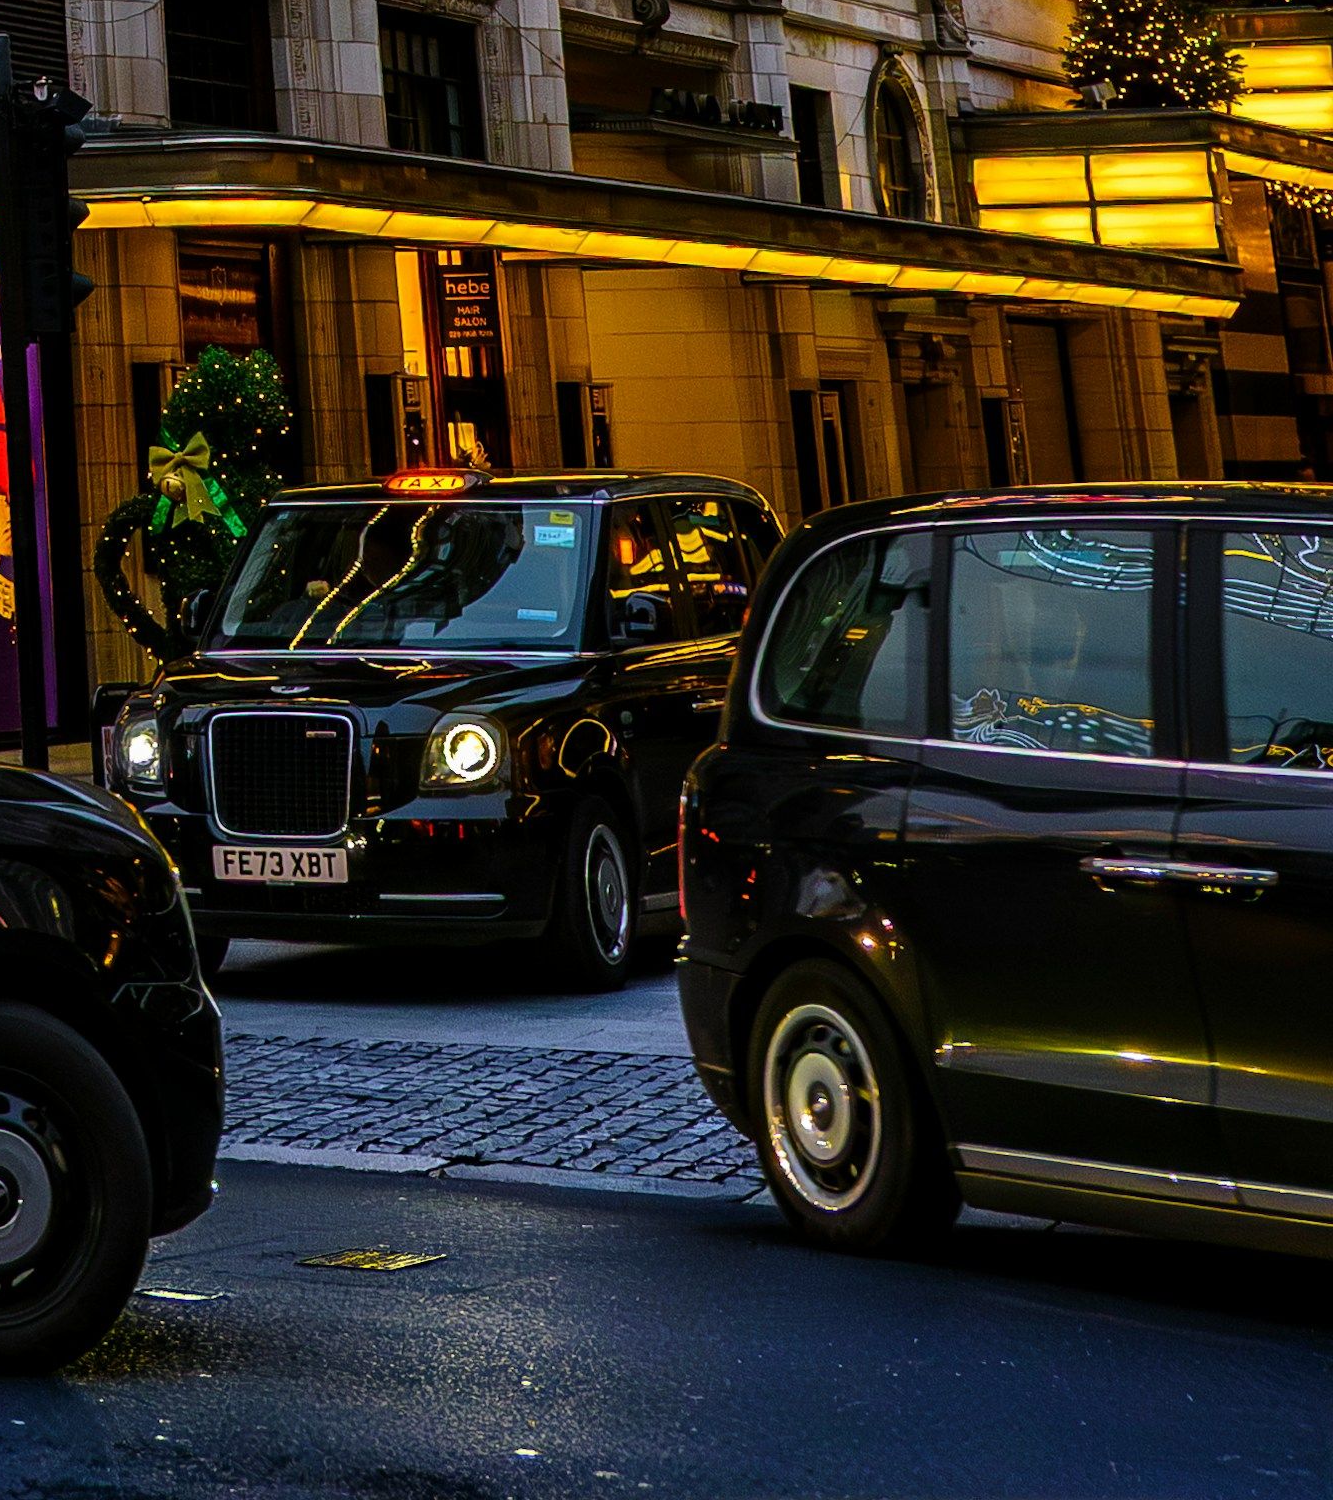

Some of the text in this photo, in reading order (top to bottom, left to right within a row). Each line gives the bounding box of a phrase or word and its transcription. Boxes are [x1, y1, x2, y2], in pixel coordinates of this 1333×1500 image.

[445, 279, 490, 294] hebe
[457, 305, 480, 315] HAIR
[453, 317, 487, 327] SALON
[397, 478, 457, 489] TAXI
[222, 850, 338, 878] FE73 XBT
